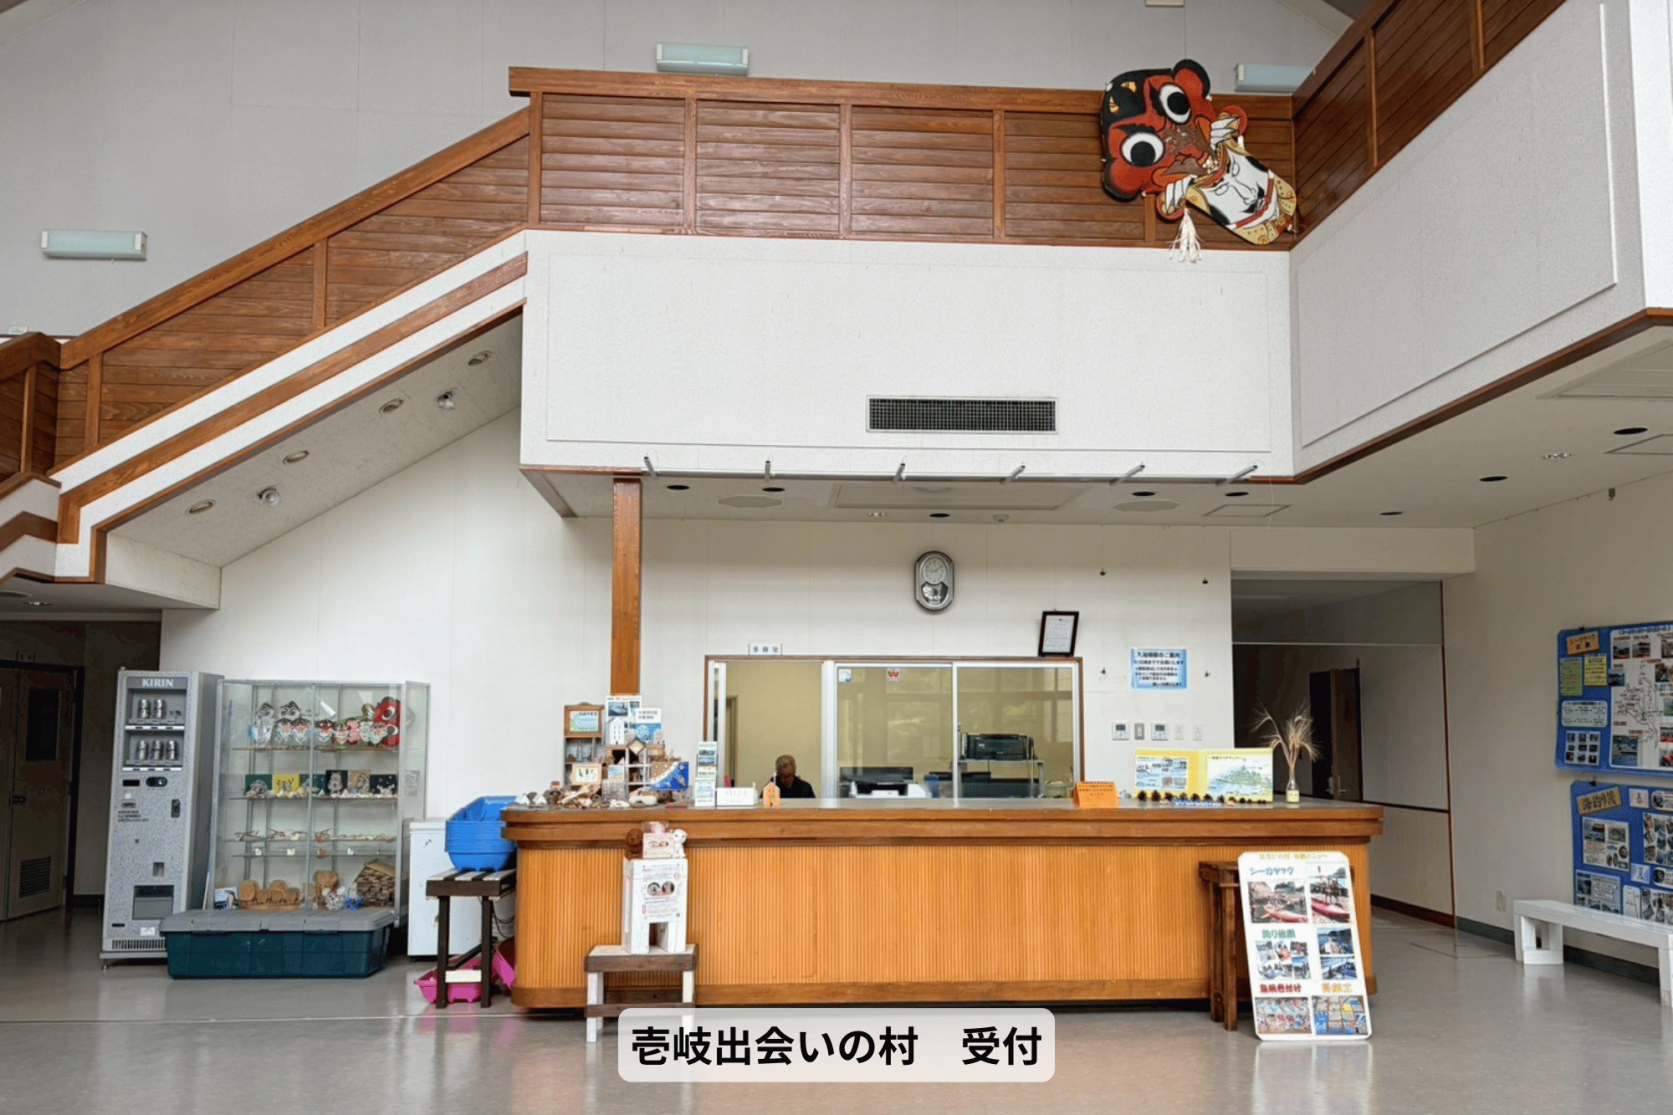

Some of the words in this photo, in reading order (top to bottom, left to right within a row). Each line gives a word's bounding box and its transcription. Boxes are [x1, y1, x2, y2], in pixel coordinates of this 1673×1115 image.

[142, 678, 174, 688] KIRIN
[1249, 866, 1295, 876] シーカヤック
